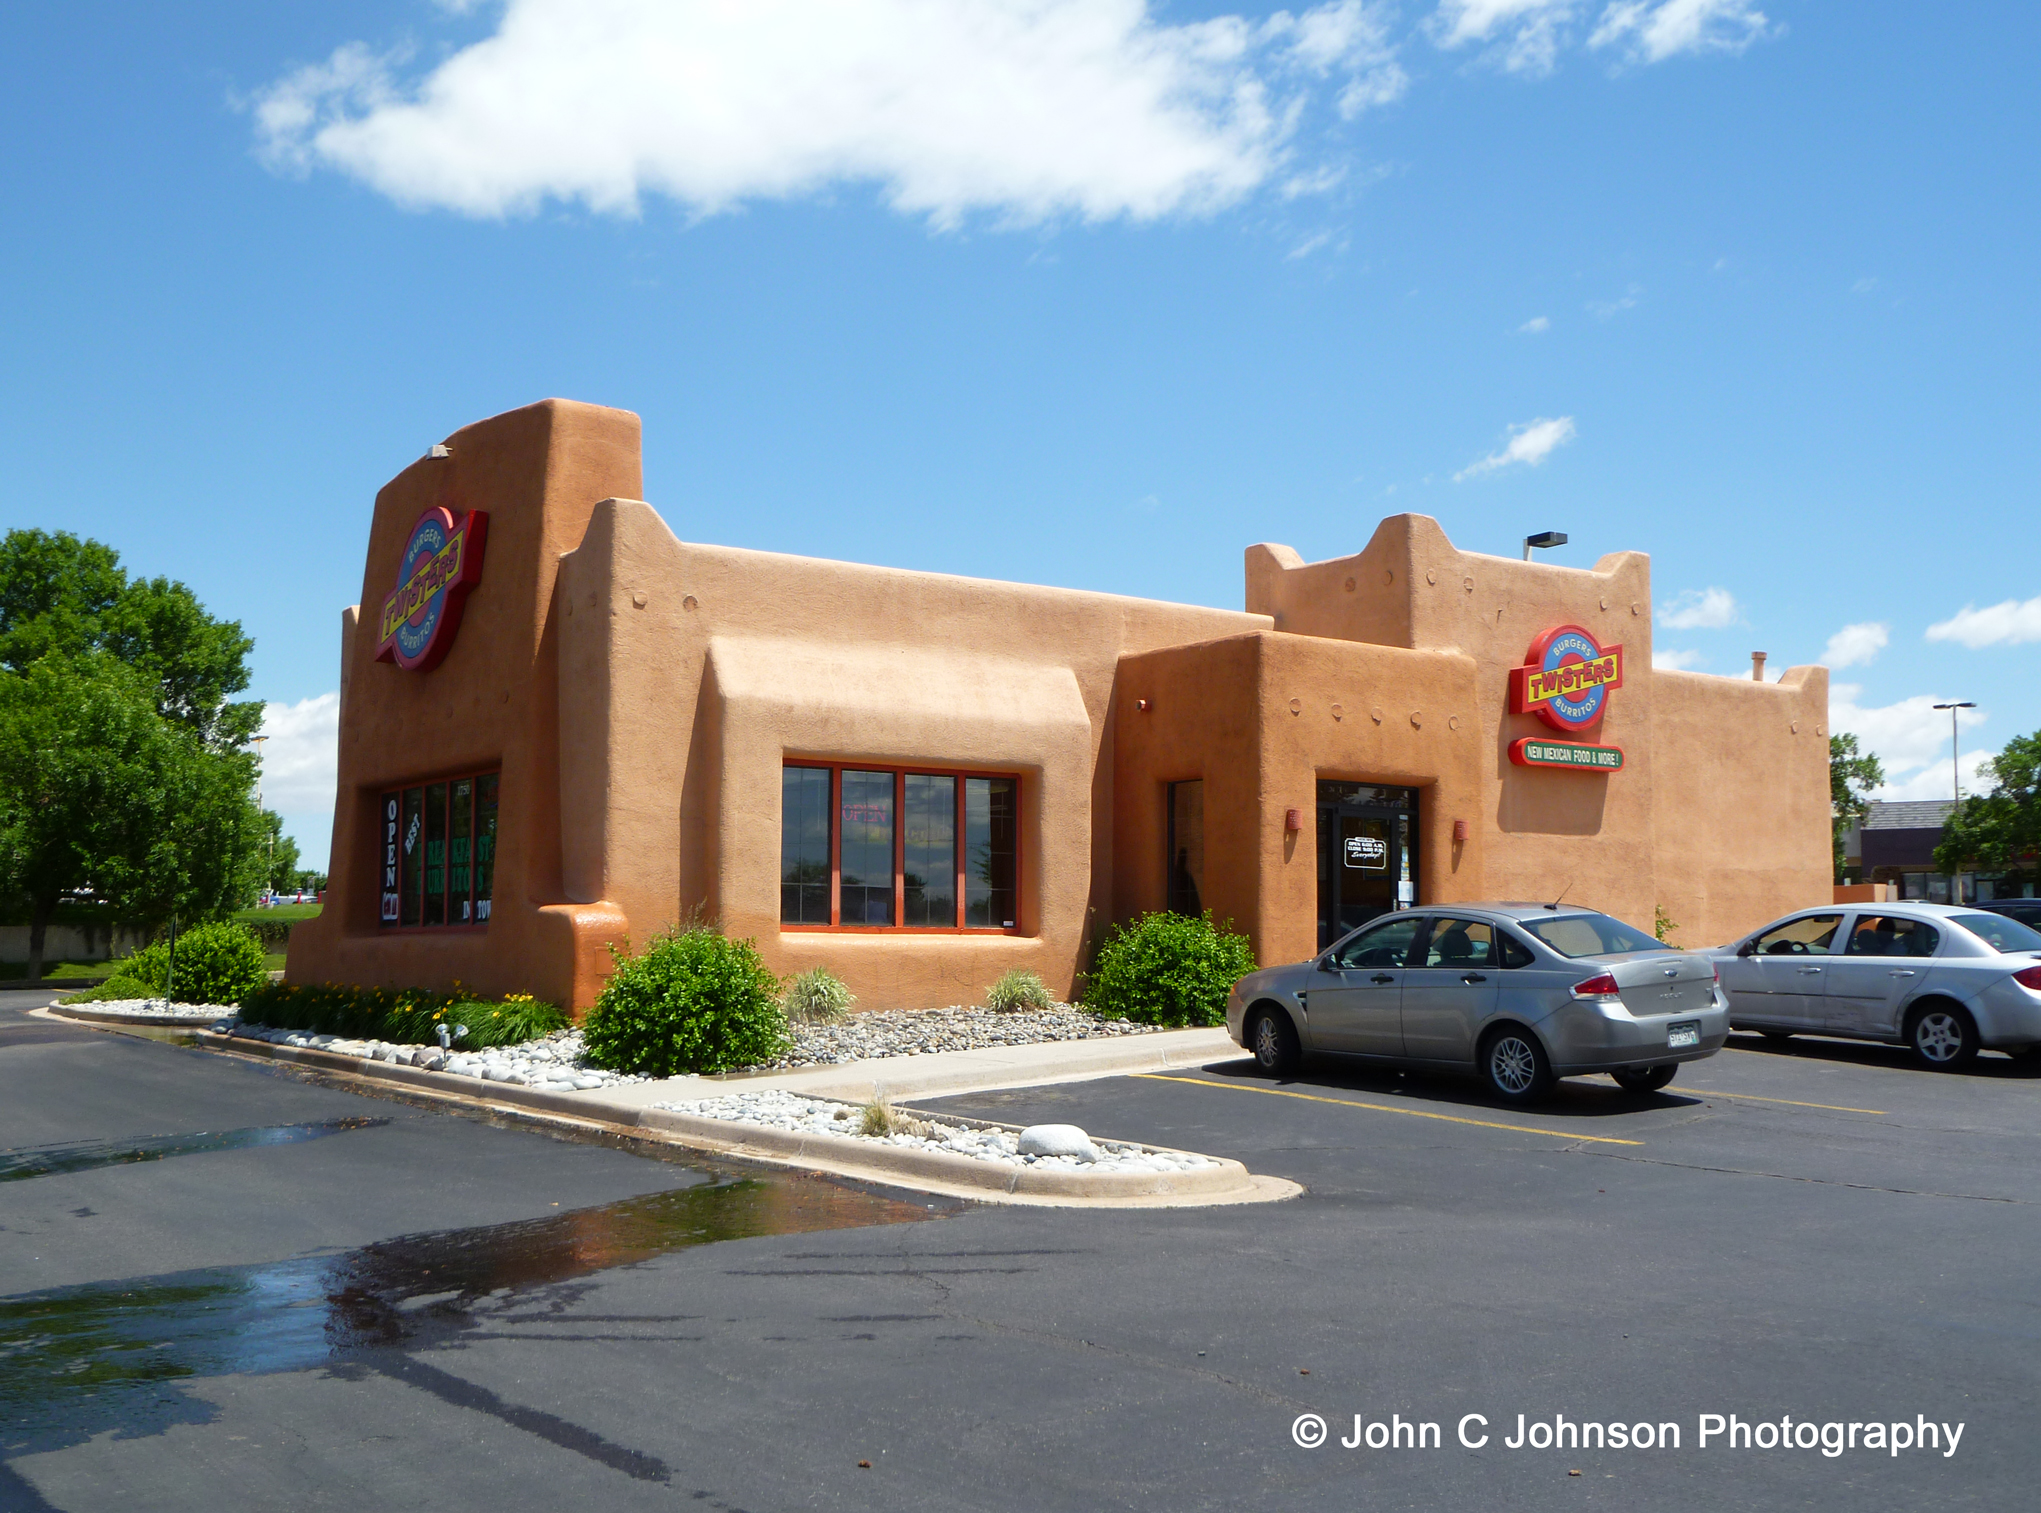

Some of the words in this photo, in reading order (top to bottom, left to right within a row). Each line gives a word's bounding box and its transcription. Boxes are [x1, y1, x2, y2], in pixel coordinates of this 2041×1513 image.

[409, 529, 441, 563] BURGERS
[385, 539, 458, 636] TWISTERS
[400, 612, 435, 649] BURRITOS
[1553, 638, 1592, 657] BURGERS
[1531, 658, 1615, 699] TWISTERS
[1555, 697, 1597, 718] BURRITOS
[1527, 745, 1543, 759] NEW
[1543, 747, 1572, 762] MEXICAN
[1574, 750, 1591, 763] FOOD
[1592, 752, 1597, 764] &
[842, 804, 886, 823] OPEN
[386, 799, 397, 887] OPEN
[404, 813, 420, 855] BEST
